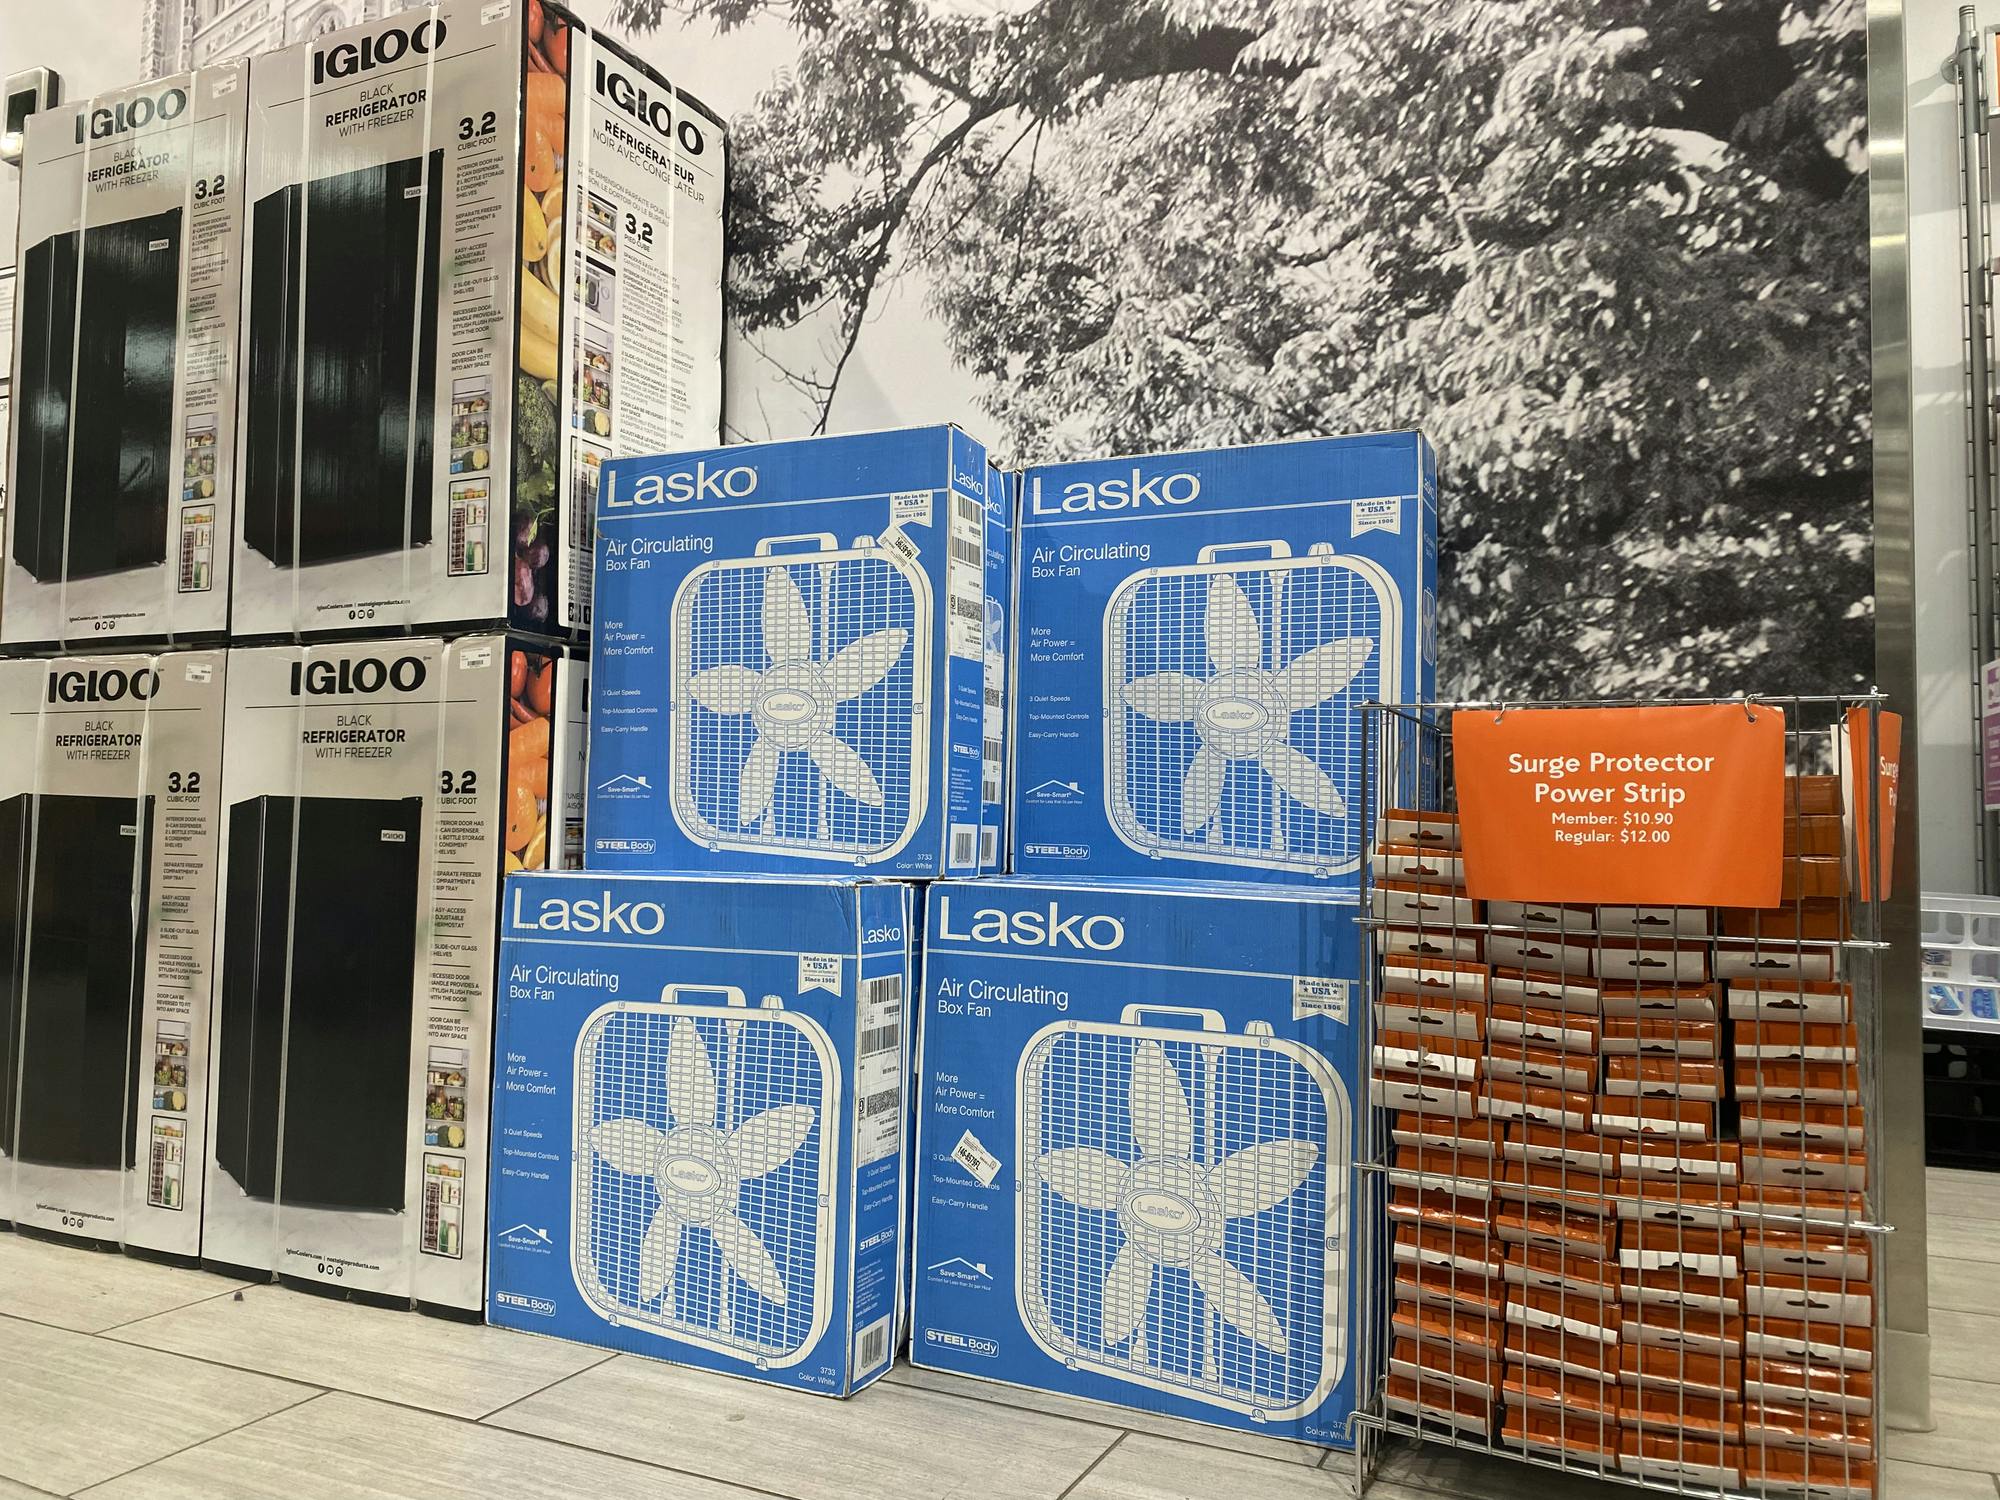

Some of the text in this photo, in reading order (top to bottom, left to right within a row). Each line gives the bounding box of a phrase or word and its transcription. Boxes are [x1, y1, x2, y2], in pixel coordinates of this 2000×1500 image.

[314, 19, 446, 84] IGLOO
[360, 83, 394, 102] BLACK
[326, 90, 427, 128] REFRIGERATOR
[596, 60, 704, 156] IGLOO
[75, 88, 187, 144] IGLOO
[339, 109, 414, 137] WITH FREEZER
[458, 111, 496, 140] 3.2
[458, 136, 496, 151] CUBIC FOOT
[593, 128, 614, 150] NOIR
[617, 145, 640, 166] AVEC
[96, 170, 159, 193] WITH FREEZER
[194, 174, 224, 200] 3.2
[210, 197, 225, 206] FOOT
[626, 213, 653, 244] 3,2
[608, 462, 757, 508] Lasko
[954, 464, 983, 496] Lasko
[1033, 468, 1200, 516] Lasko
[606, 535, 714, 556] Air Circulating
[1032, 542, 1150, 563] Air Circulating
[606, 558, 650, 572] Box Fan
[1032, 566, 1080, 578] Box Fan
[604, 621, 623, 630] More
[1031, 627, 1050, 636] More
[604, 632, 639, 641] Air Power
[1030, 638, 1068, 648] Air Power
[604, 646, 654, 656] More Comfort
[1030, 652, 1084, 662] More Comfort
[290, 656, 426, 696] IGLOO
[48, 668, 160, 703] IGLOO
[85, 721, 113, 732] BLACK
[336, 714, 372, 726] BLACK
[56, 734, 142, 746] REFRIGERATOR
[302, 728, 406, 744] REFRIGERATOR
[66, 750, 130, 760] WITH FREEZER
[315, 746, 392, 758] WITH FREEZER
[1508, 752, 1714, 778] Surge Protector
[168, 772, 200, 794] 3.2
[441, 770, 476, 794] 3.2
[1536, 782, 1686, 808] Power Strip
[1552, 812, 1674, 826] Member: $10.90
[1556, 830, 1670, 845] Regular: $12.00
[512, 888, 664, 935] Lasko
[940, 896, 1124, 950] Lasko
[862, 925, 900, 944] Lasko
[510, 964, 618, 992] Air Circulating
[510, 986, 554, 1000] Box Fan
[938, 978, 1068, 1011] Air Circulating
[938, 1000, 990, 1016] Box Fan
[508, 1053, 526, 1062] More
[507, 1067, 542, 1077] Air Power
[936, 1072, 958, 1082] More
[506, 1082, 556, 1094] More Comfort
[936, 1088, 976, 1100] Air Power
[935, 1104, 994, 1118] More Comfort
[524, 1131, 542, 1139] Speeds
[503, 1148, 559, 1161] Top-Mounted Controls
[502, 1168, 530, 1179] Easy-Carry
[932, 1175, 972, 1187] Top-Mounted
[932, 1197, 988, 1210] Easy-Carry Handle
[940, 1268, 976, 1280] Save-Smart
[820, 1366, 836, 1376] 3733
[798, 1372, 836, 1386] Color: White
[1333, 1421, 1347, 1430] 373
[1305, 1426, 1352, 1441] Color: Whi
